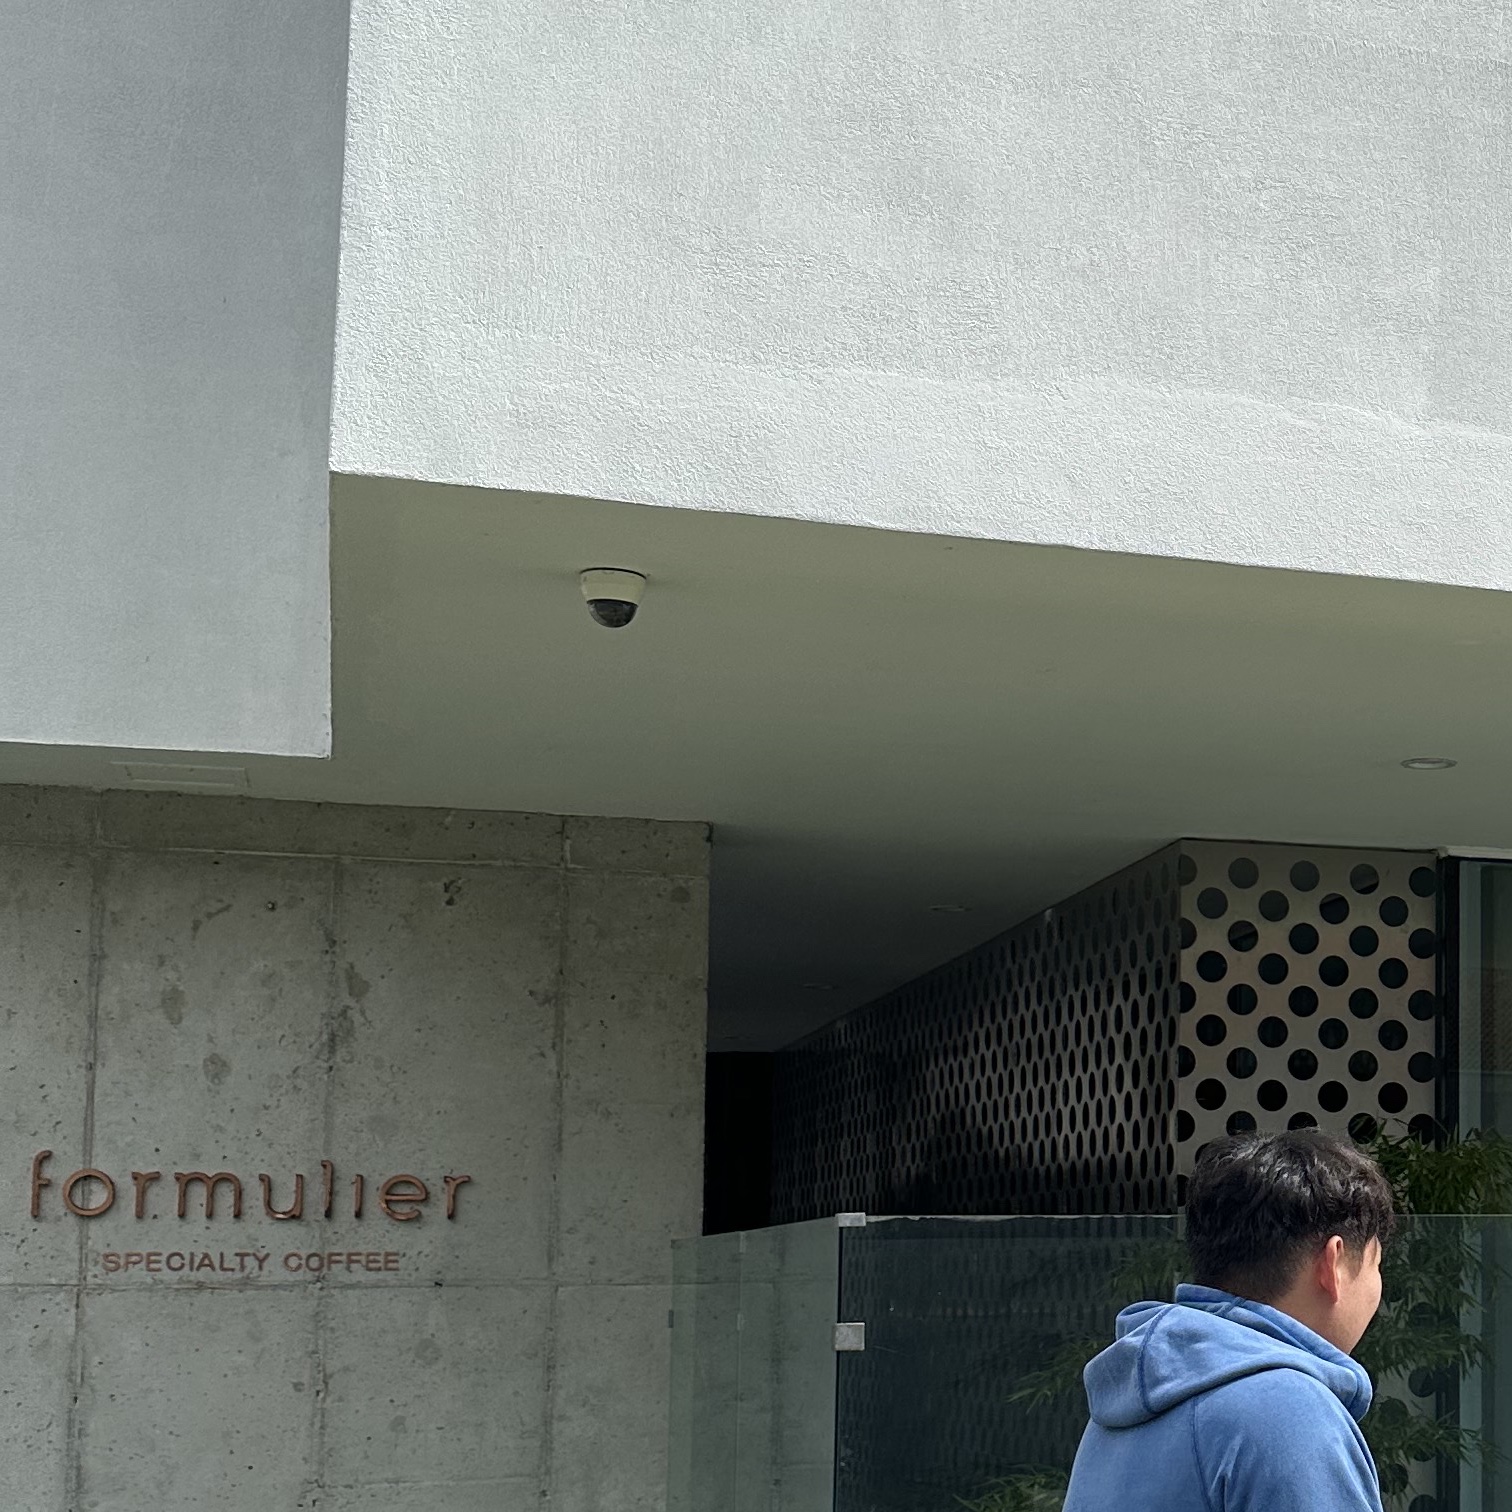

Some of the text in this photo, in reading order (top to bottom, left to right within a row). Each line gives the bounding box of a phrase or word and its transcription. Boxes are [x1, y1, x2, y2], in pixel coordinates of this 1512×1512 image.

[31, 1149, 471, 1222] formulier
[101, 1251, 401, 1273] SPECIALTY COFFEE
